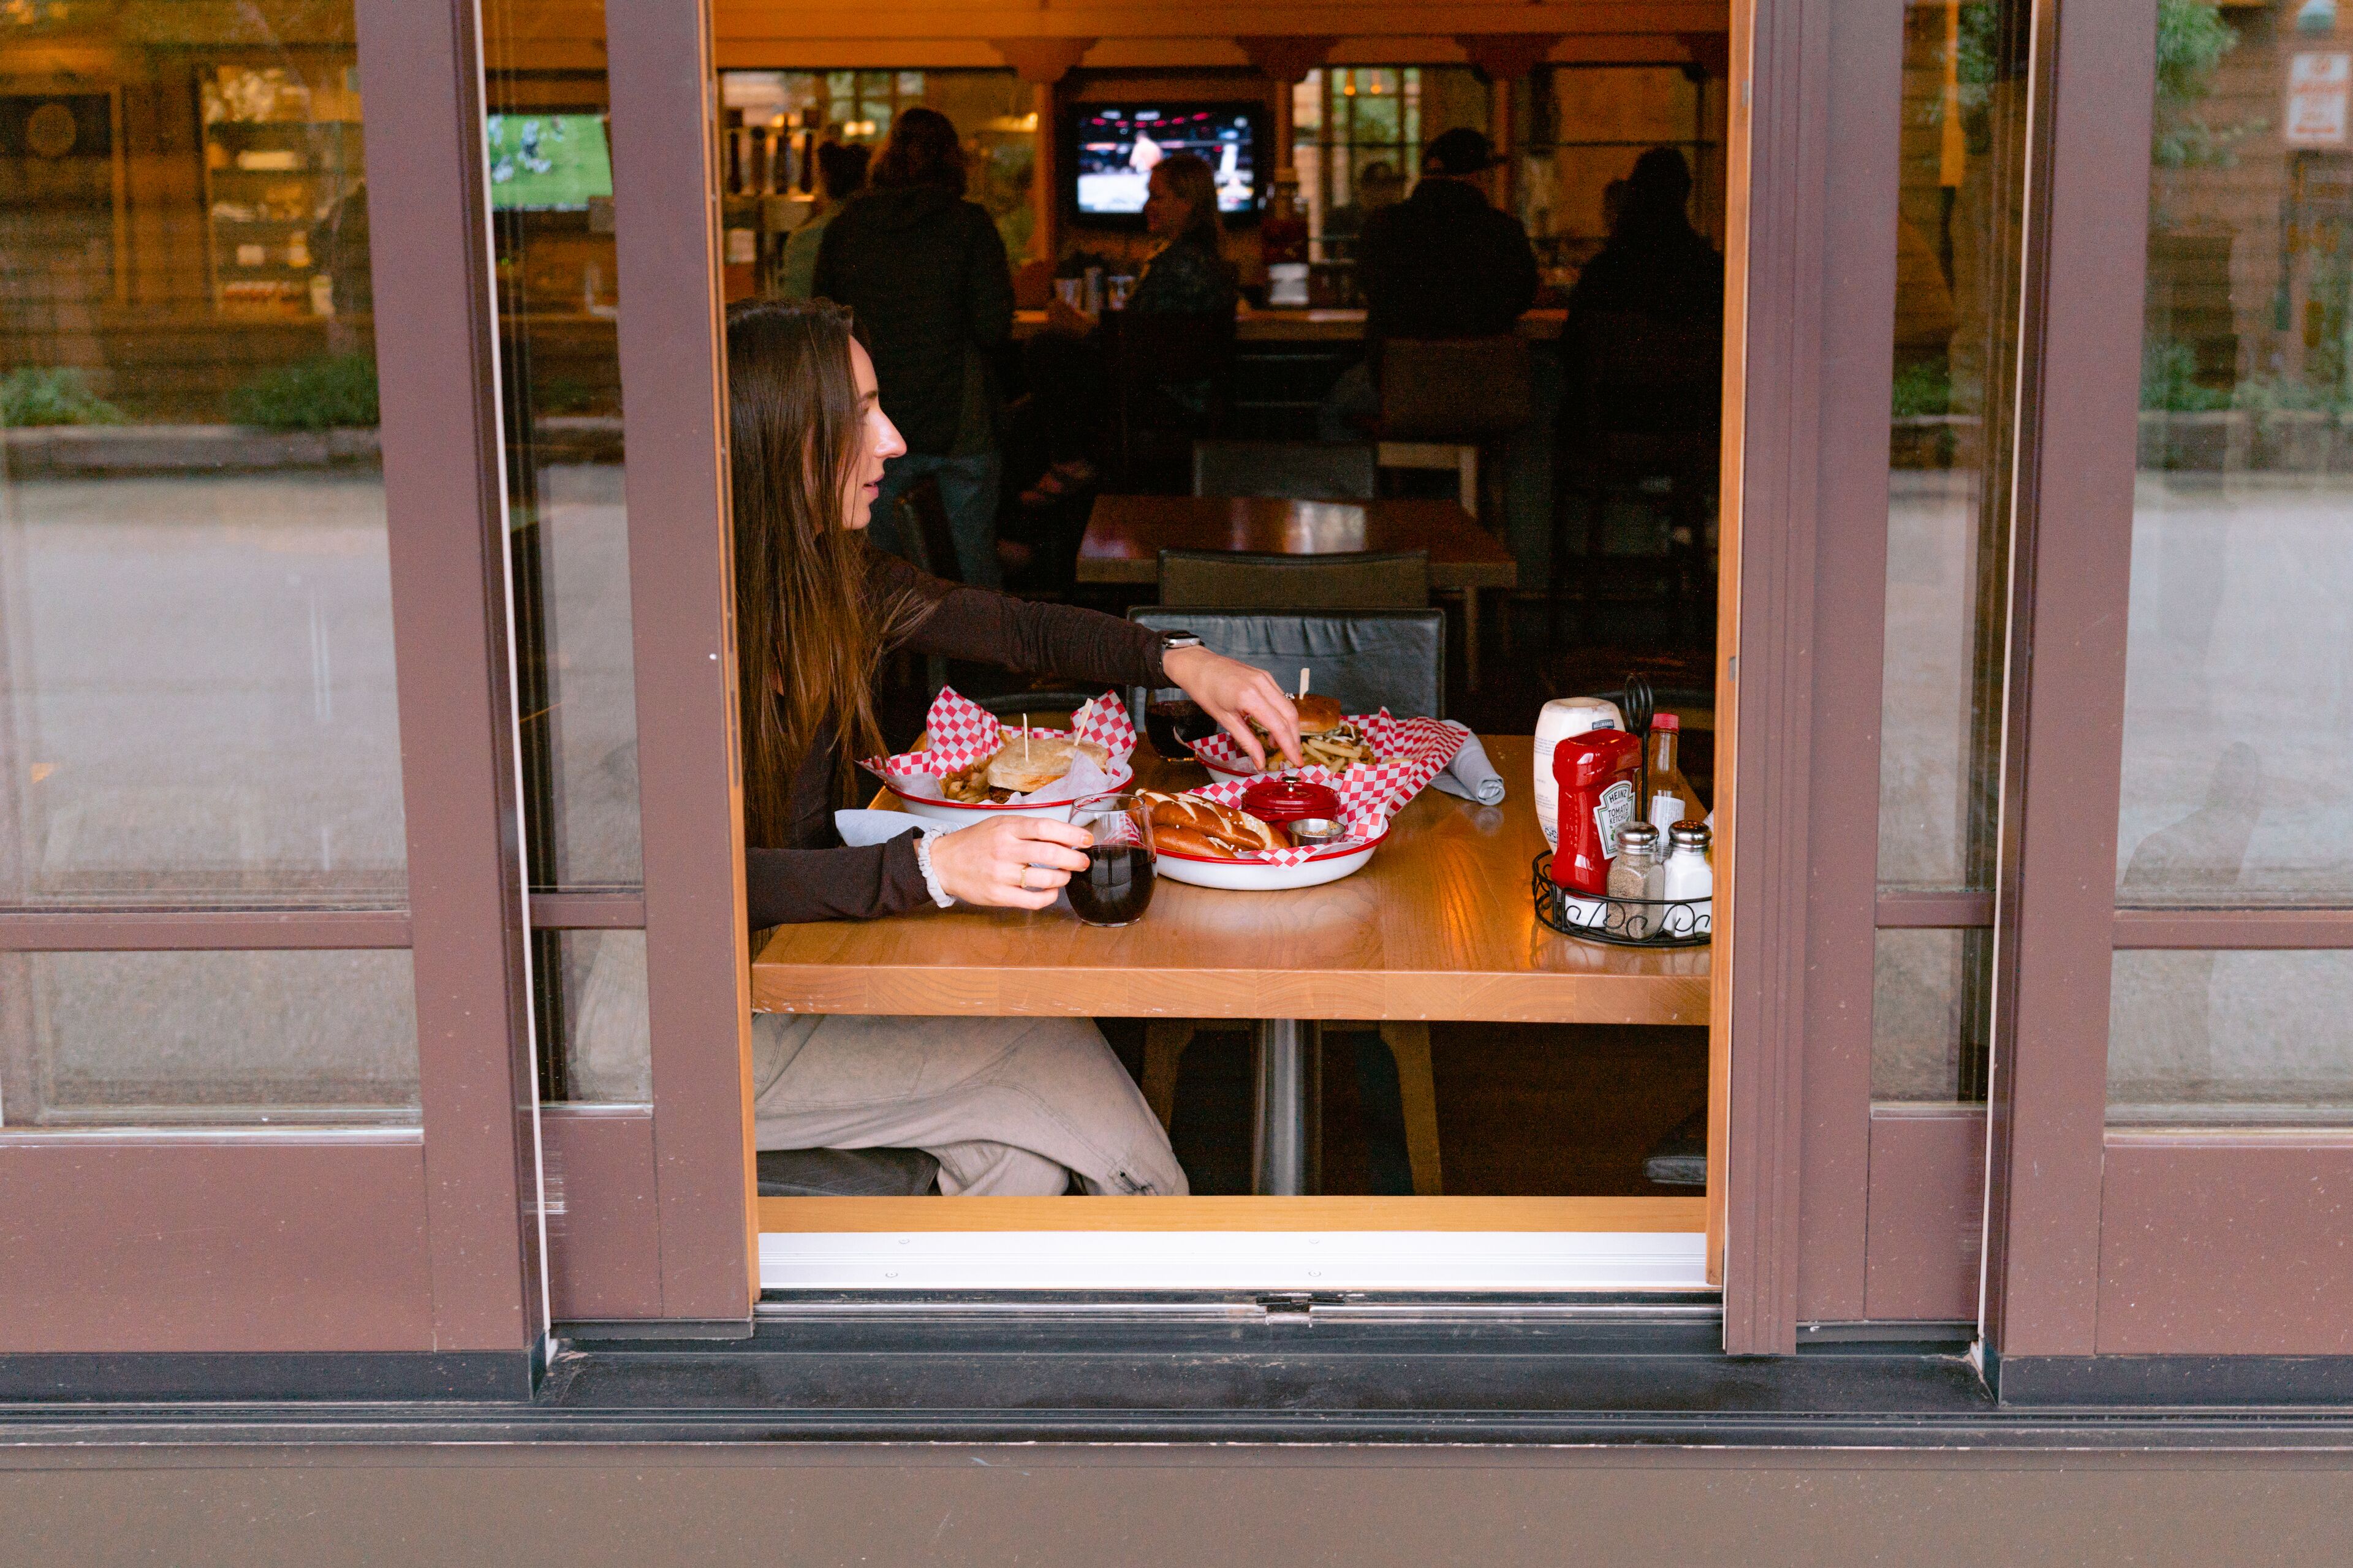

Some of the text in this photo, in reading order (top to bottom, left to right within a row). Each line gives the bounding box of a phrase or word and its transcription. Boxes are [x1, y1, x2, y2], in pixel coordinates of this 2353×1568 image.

[1609, 789, 1627, 803] HEINZ
[1608, 803, 1629, 817] TOMATO
[1609, 812, 1628, 824] KETCHUP
